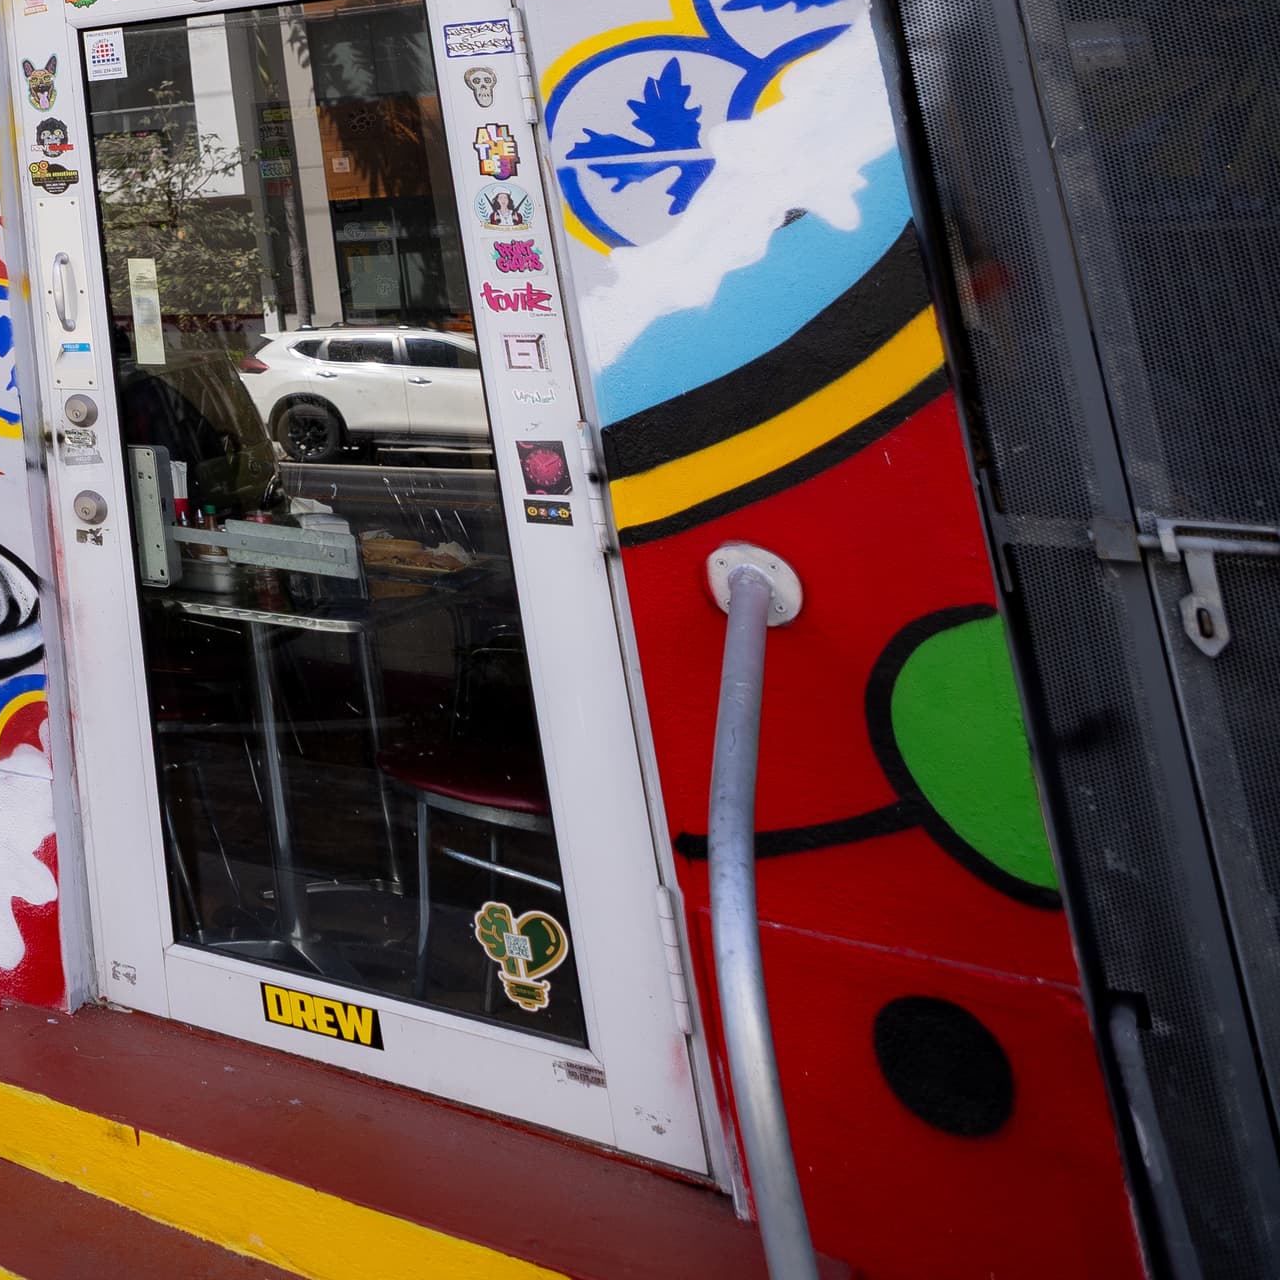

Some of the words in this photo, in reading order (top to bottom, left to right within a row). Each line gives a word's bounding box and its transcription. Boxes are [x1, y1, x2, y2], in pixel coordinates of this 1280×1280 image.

[478, 125, 513, 144] ALL
[475, 141, 515, 161] THE
[481, 156, 517, 179] BEST
[264, 984, 375, 1048] DREW
